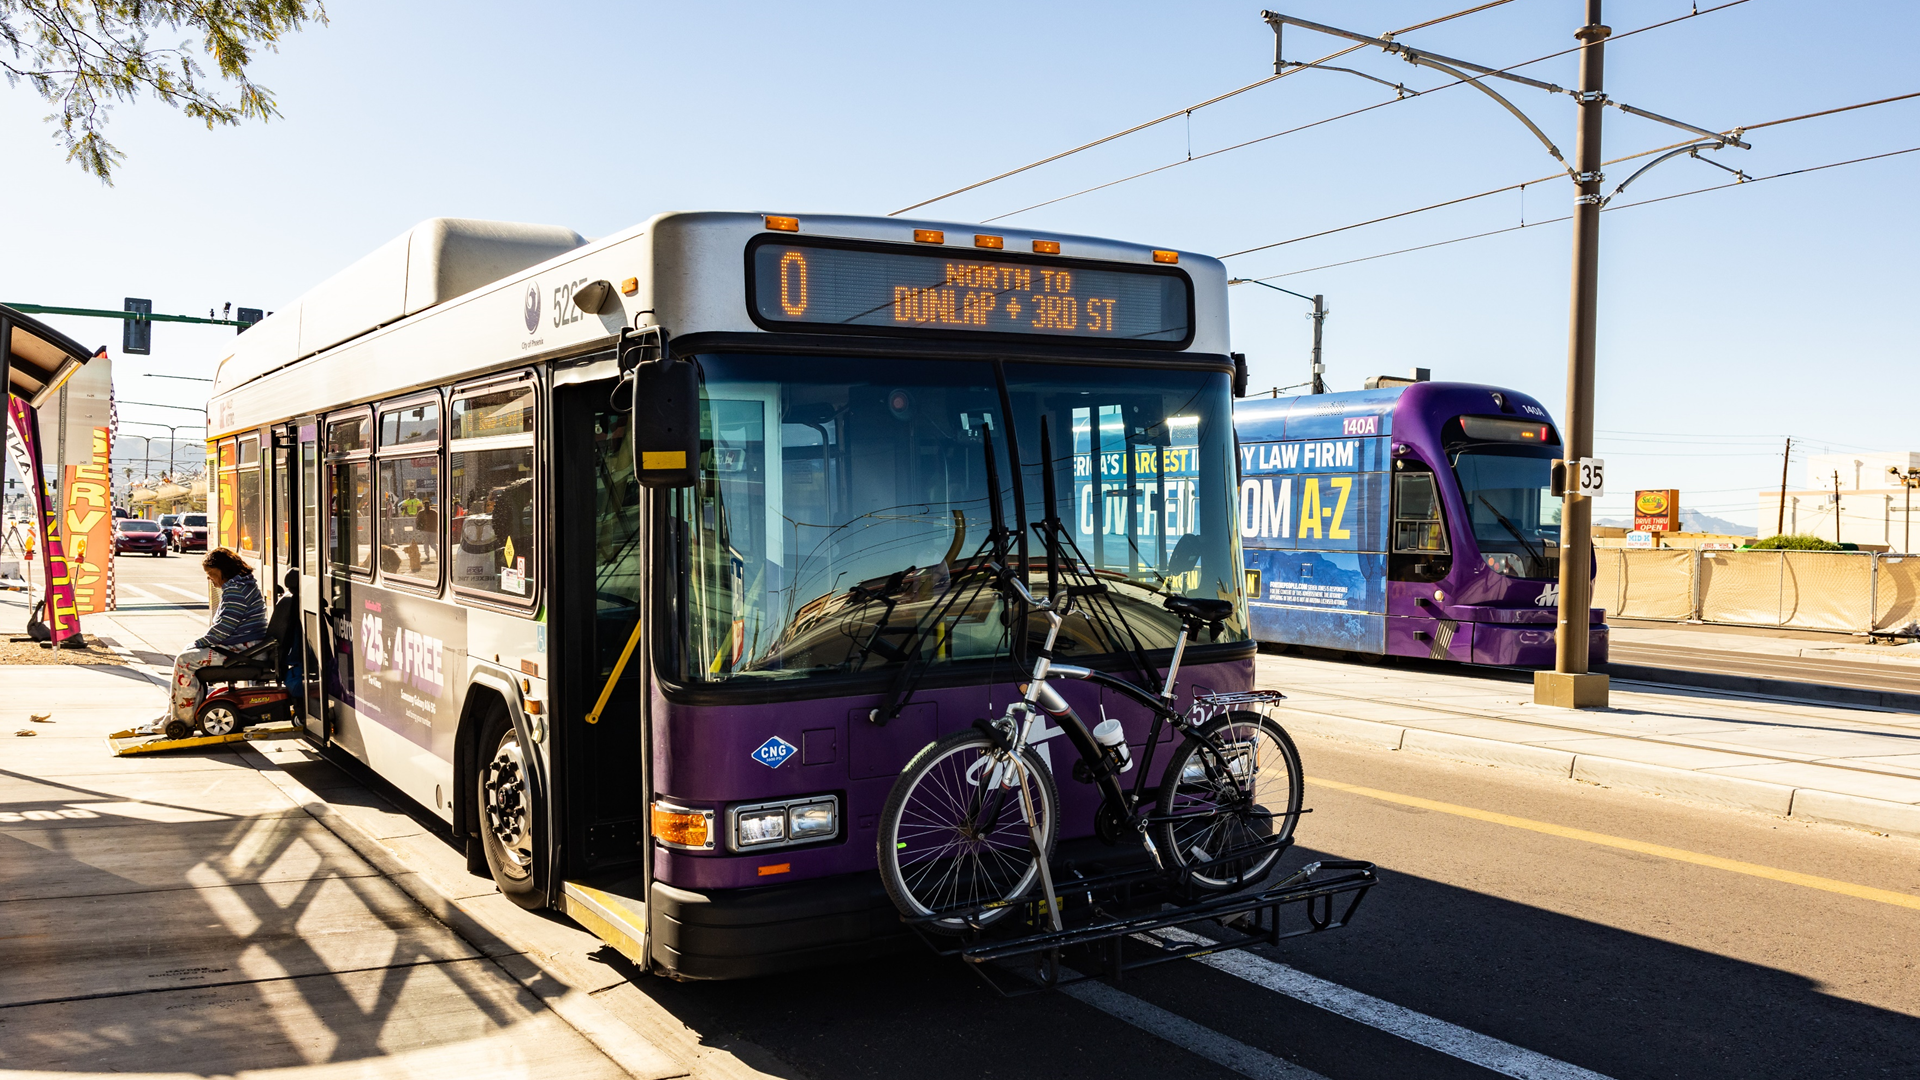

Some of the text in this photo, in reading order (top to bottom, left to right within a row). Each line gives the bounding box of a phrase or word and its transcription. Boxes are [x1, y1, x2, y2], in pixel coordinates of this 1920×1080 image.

[945, 263, 1071, 294] NORTH TO
[894, 286, 997, 325] DUNLAP
[1031, 295, 1077, 329] 3RD
[1087, 298, 1116, 331] ST
[1522, 405, 1545, 417] 140A
[1343, 418, 1375, 435] 140A
[1259, 443, 1300, 470] LAW
[1581, 464, 1603, 490] 35
[1298, 477, 1353, 540] A-Z
[1635, 517, 1668, 525] DRIVE THRU
[1628, 534, 1650, 542] MID K
[362, 612, 384, 666] $25
[393, 626, 403, 670] 4
[404, 628, 444, 687] FREE
[761, 745, 787, 758] CNG
